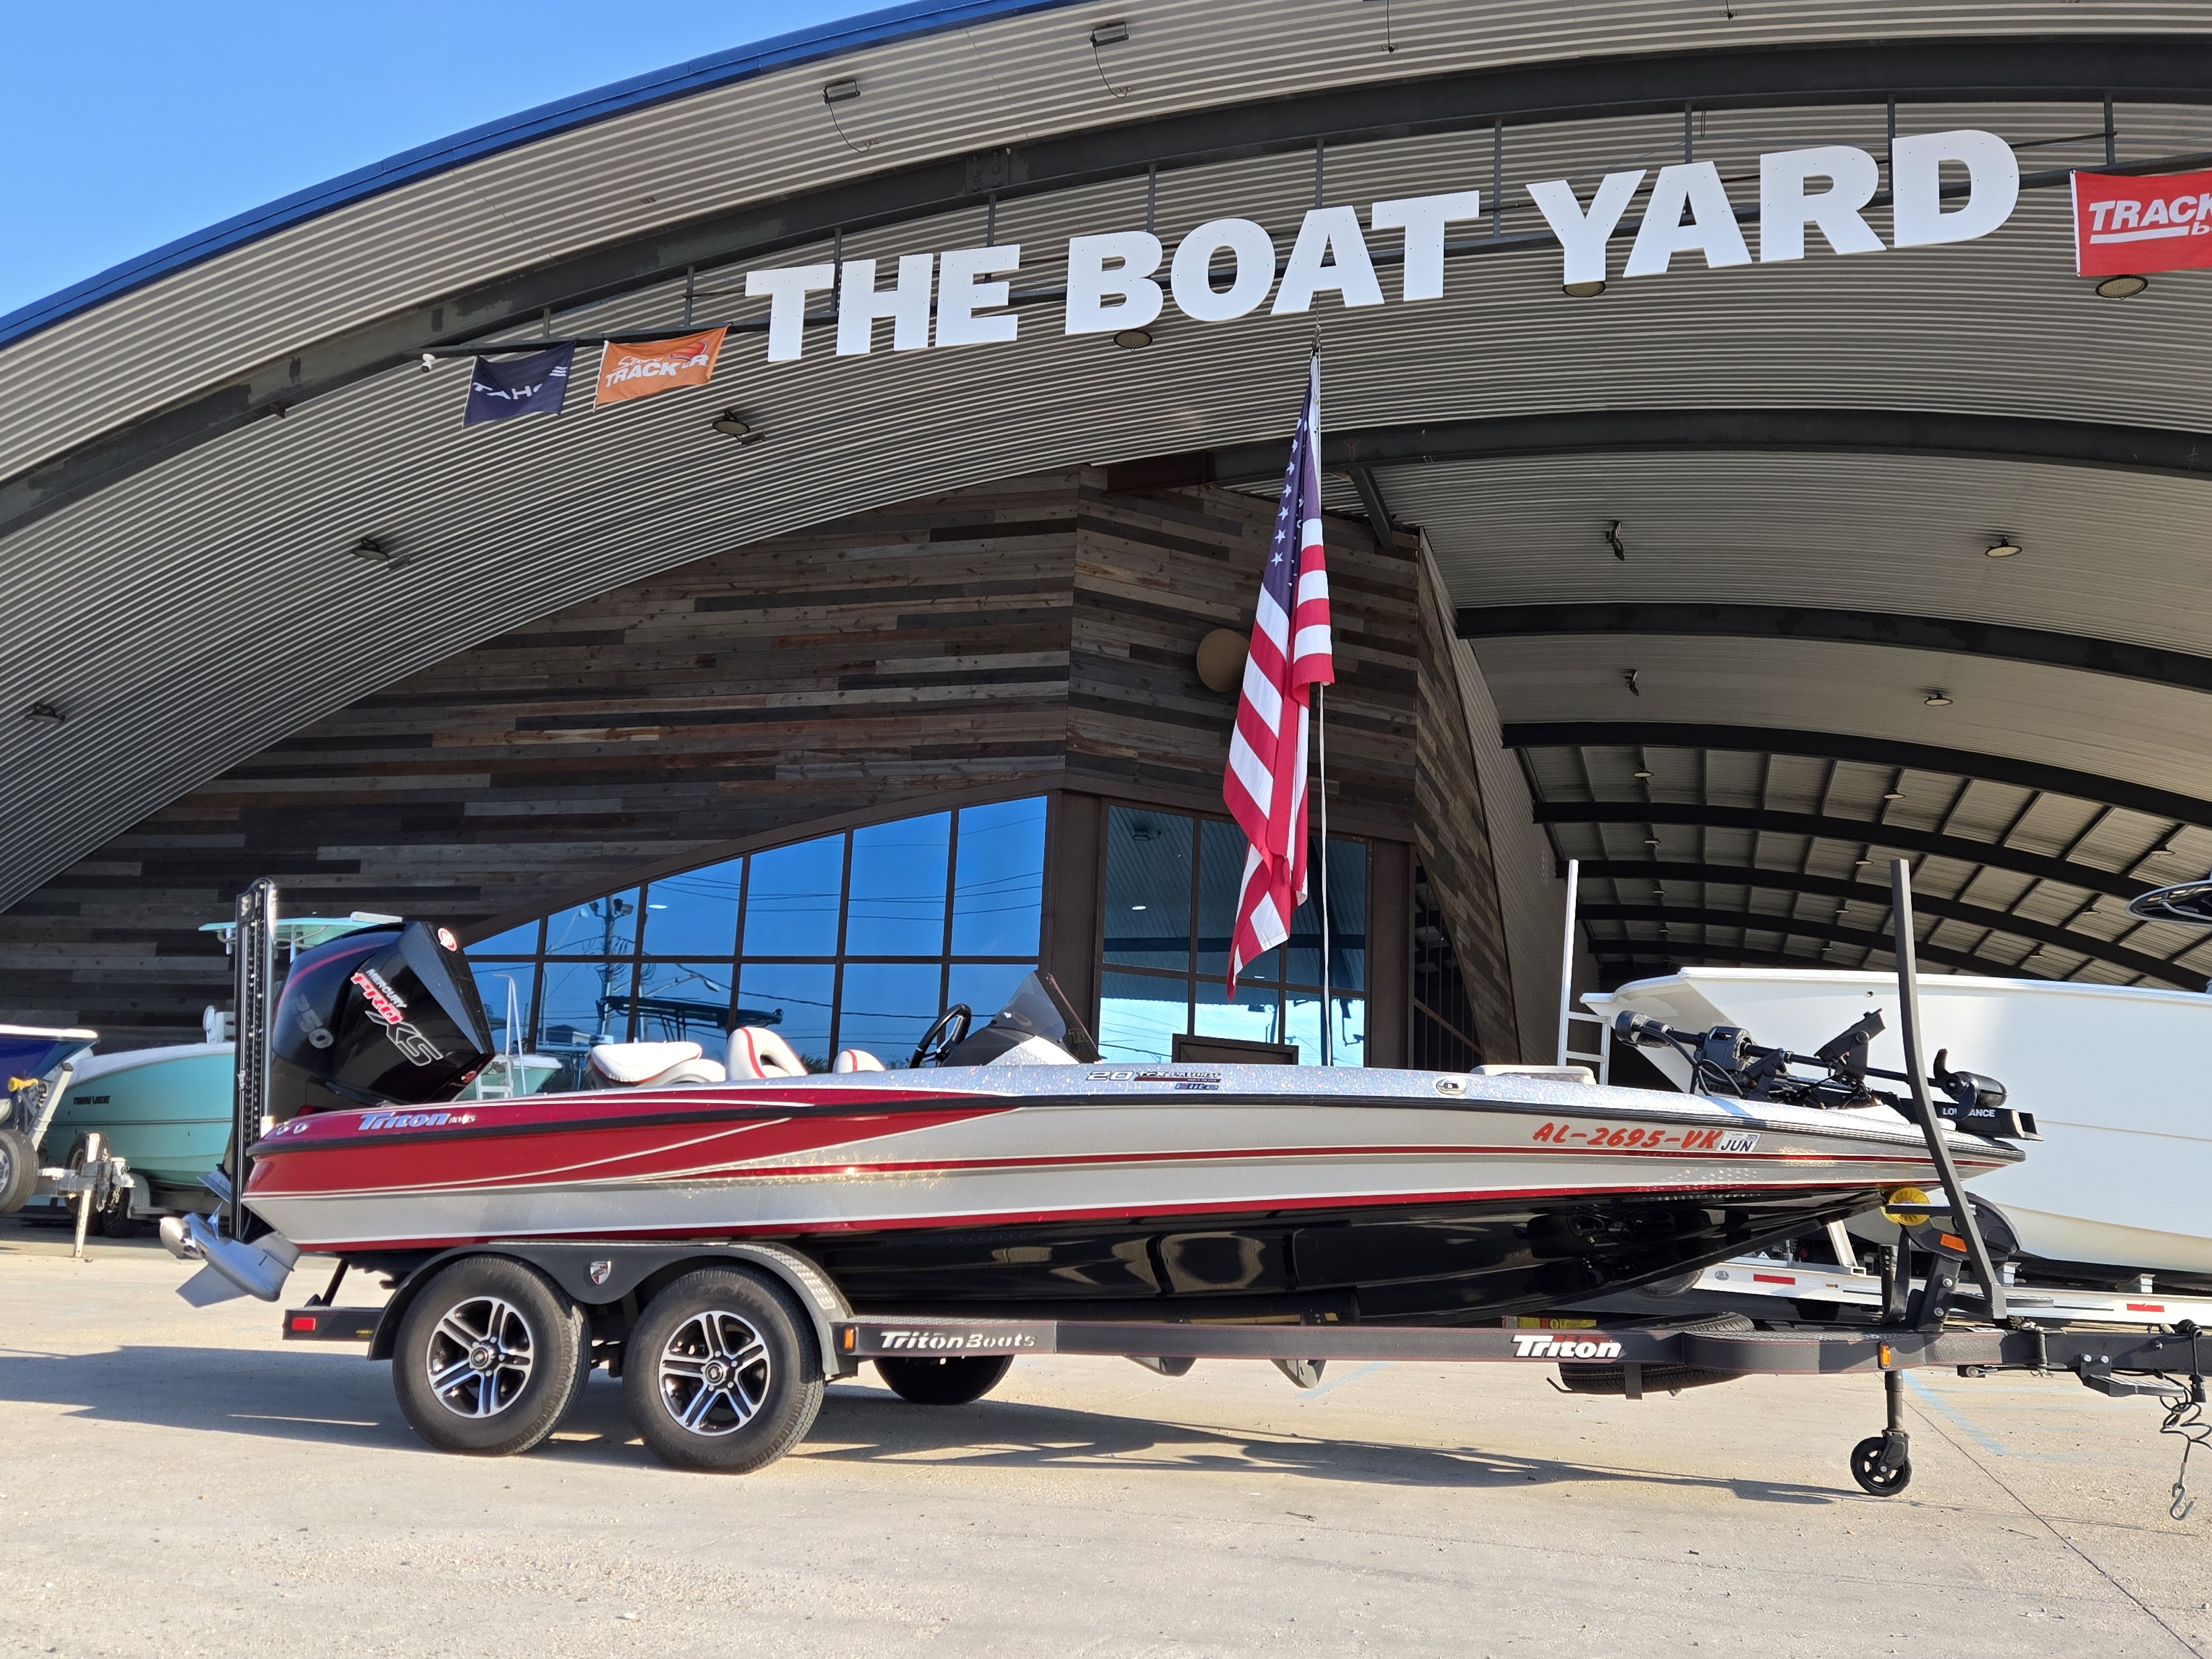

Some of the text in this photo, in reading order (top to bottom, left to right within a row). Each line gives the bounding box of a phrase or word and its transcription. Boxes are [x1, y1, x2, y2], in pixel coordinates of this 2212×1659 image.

[745, 129, 2020, 362] THE BOAT YARD
[472, 366, 569, 400] TAHE
[351, 972, 404, 1025] PRO
[366, 968, 408, 1009] MERCURY
[365, 1010, 444, 1067] XS
[1086, 1071, 1135, 1081] 20
[92, 1095, 111, 1104] VEE
[1942, 1108, 1995, 1118] LOANCE
[358, 1111, 452, 1131] Triton
[1532, 1121, 1724, 1150] AL-2695-VK
[1720, 1139, 1754, 1152] JUN
[1512, 1334, 1623, 1359] Triton
